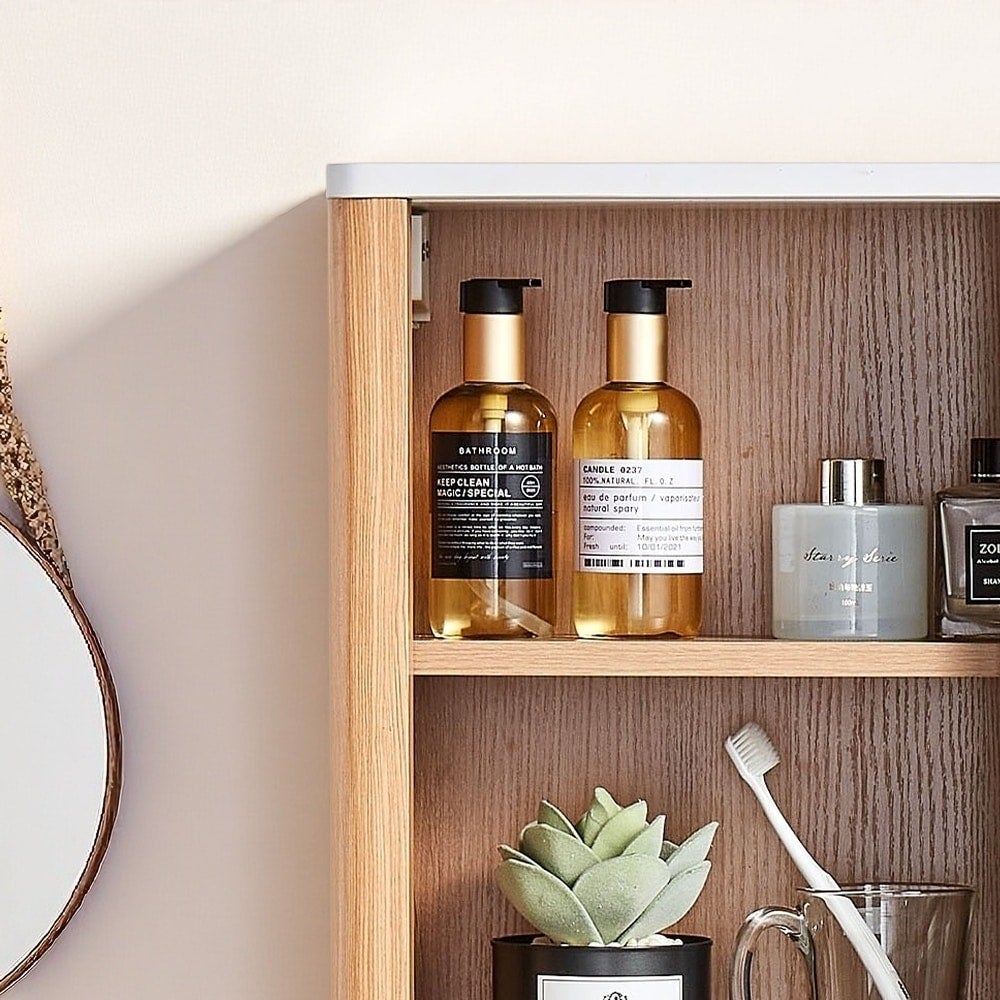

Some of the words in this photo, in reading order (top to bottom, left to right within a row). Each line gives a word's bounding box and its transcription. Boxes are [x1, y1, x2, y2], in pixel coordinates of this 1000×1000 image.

[458, 446, 517, 455] BATHROOM
[582, 465, 615, 474] CANDLE
[620, 466, 643, 474] 0237
[437, 478, 456, 487] KEEP
[457, 478, 490, 487] CLEAN
[583, 494, 596, 502] eau
[599, 493, 609, 502] de
[613, 493, 647, 504] parfum
[583, 505, 610, 513] natural
[613, 506, 639, 514] spary
[637, 543, 682, 551] 10/01/2021
